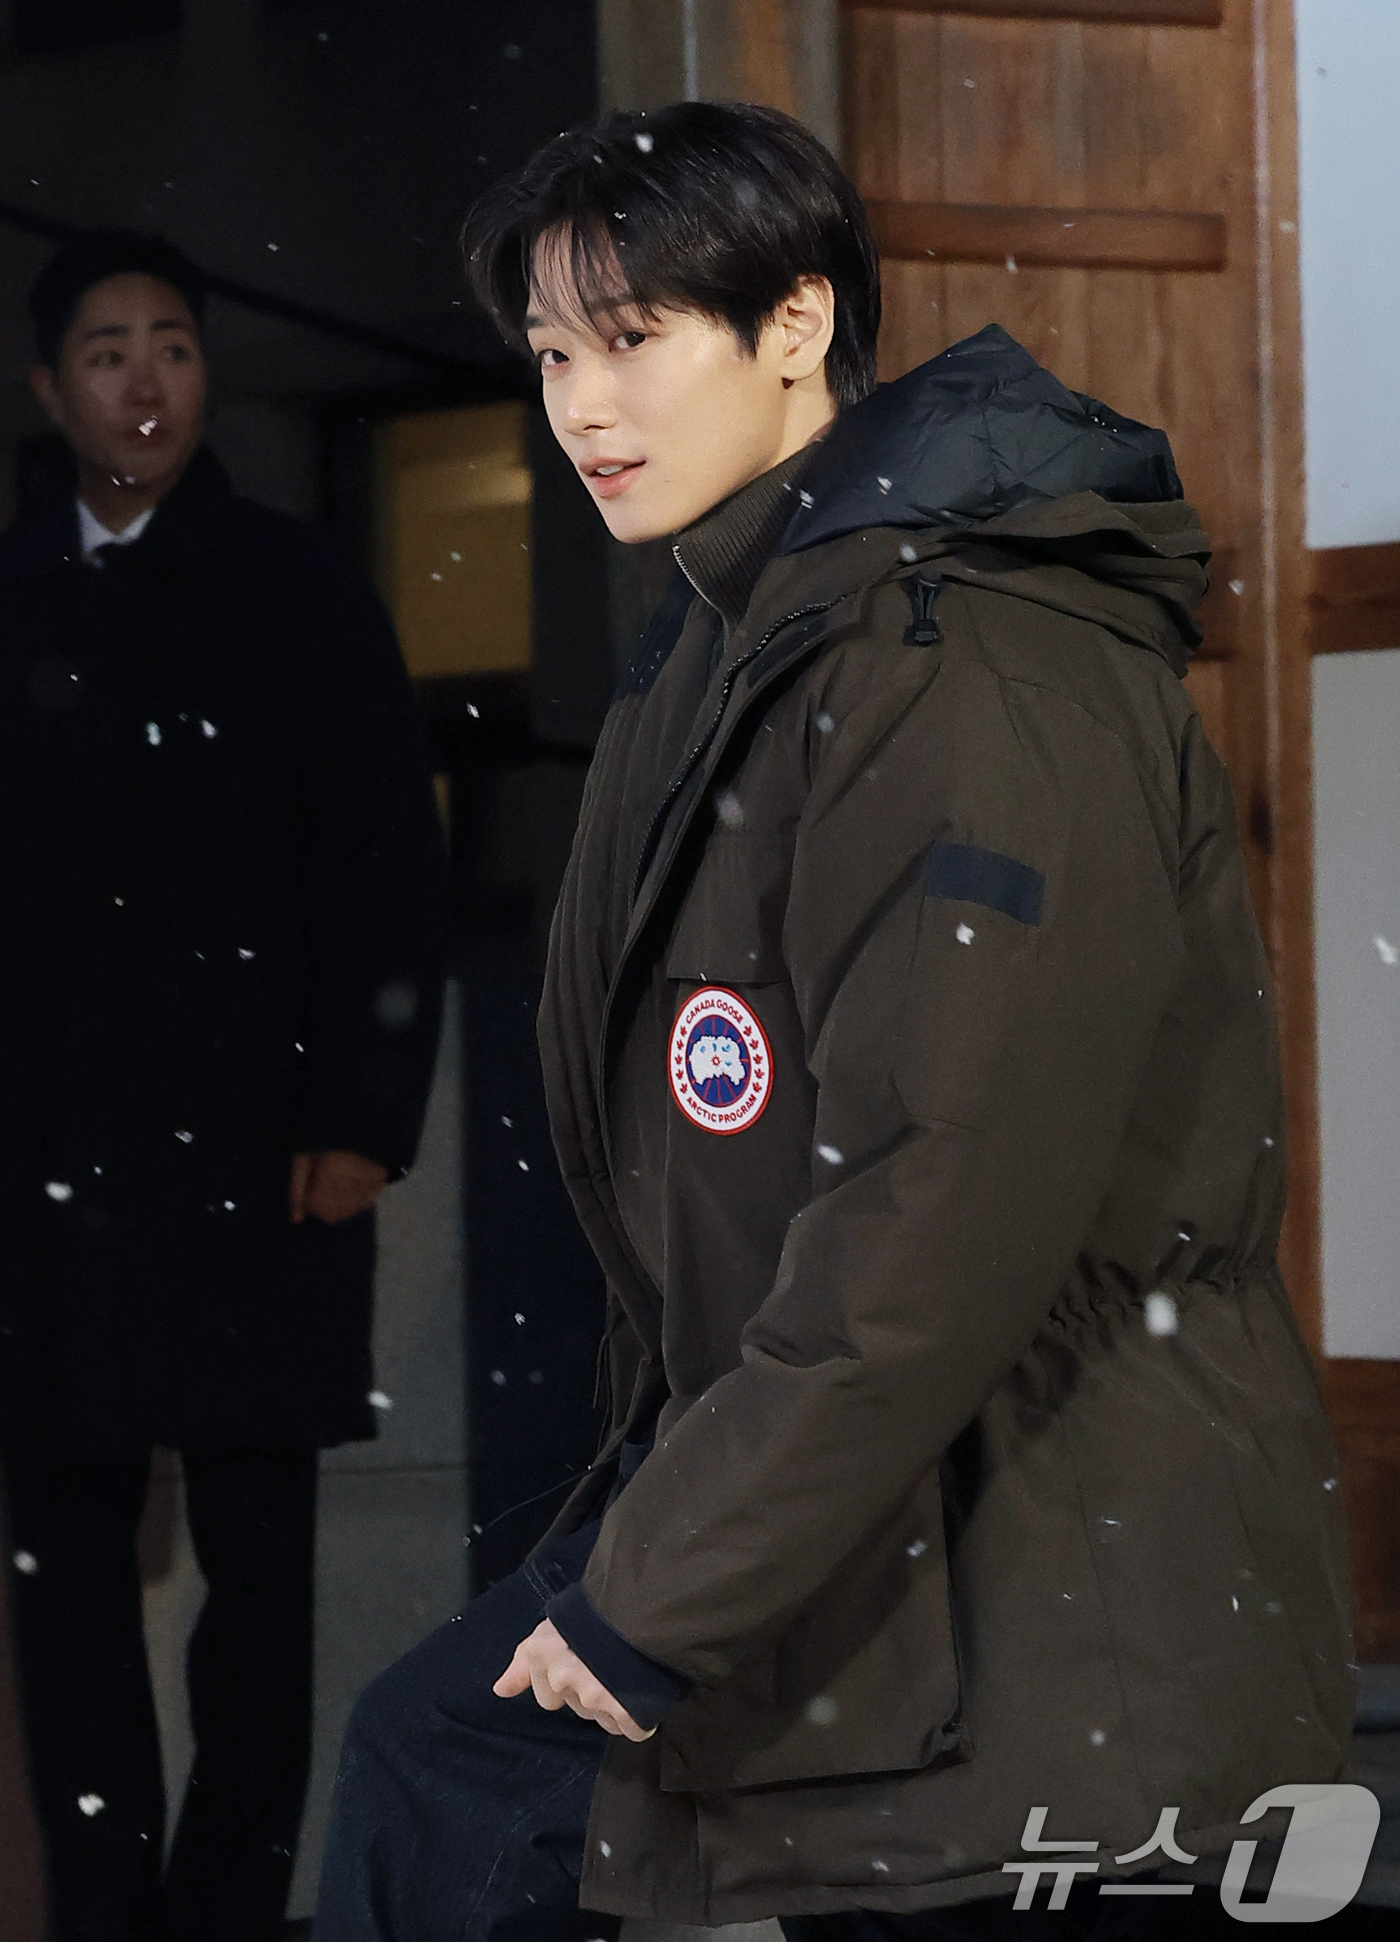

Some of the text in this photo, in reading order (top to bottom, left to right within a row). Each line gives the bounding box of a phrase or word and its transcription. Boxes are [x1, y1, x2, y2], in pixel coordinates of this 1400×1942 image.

[686, 999, 743, 1024] CANADA GOOSE
[686, 1094, 757, 1123] ARCTIC PROGRAM
